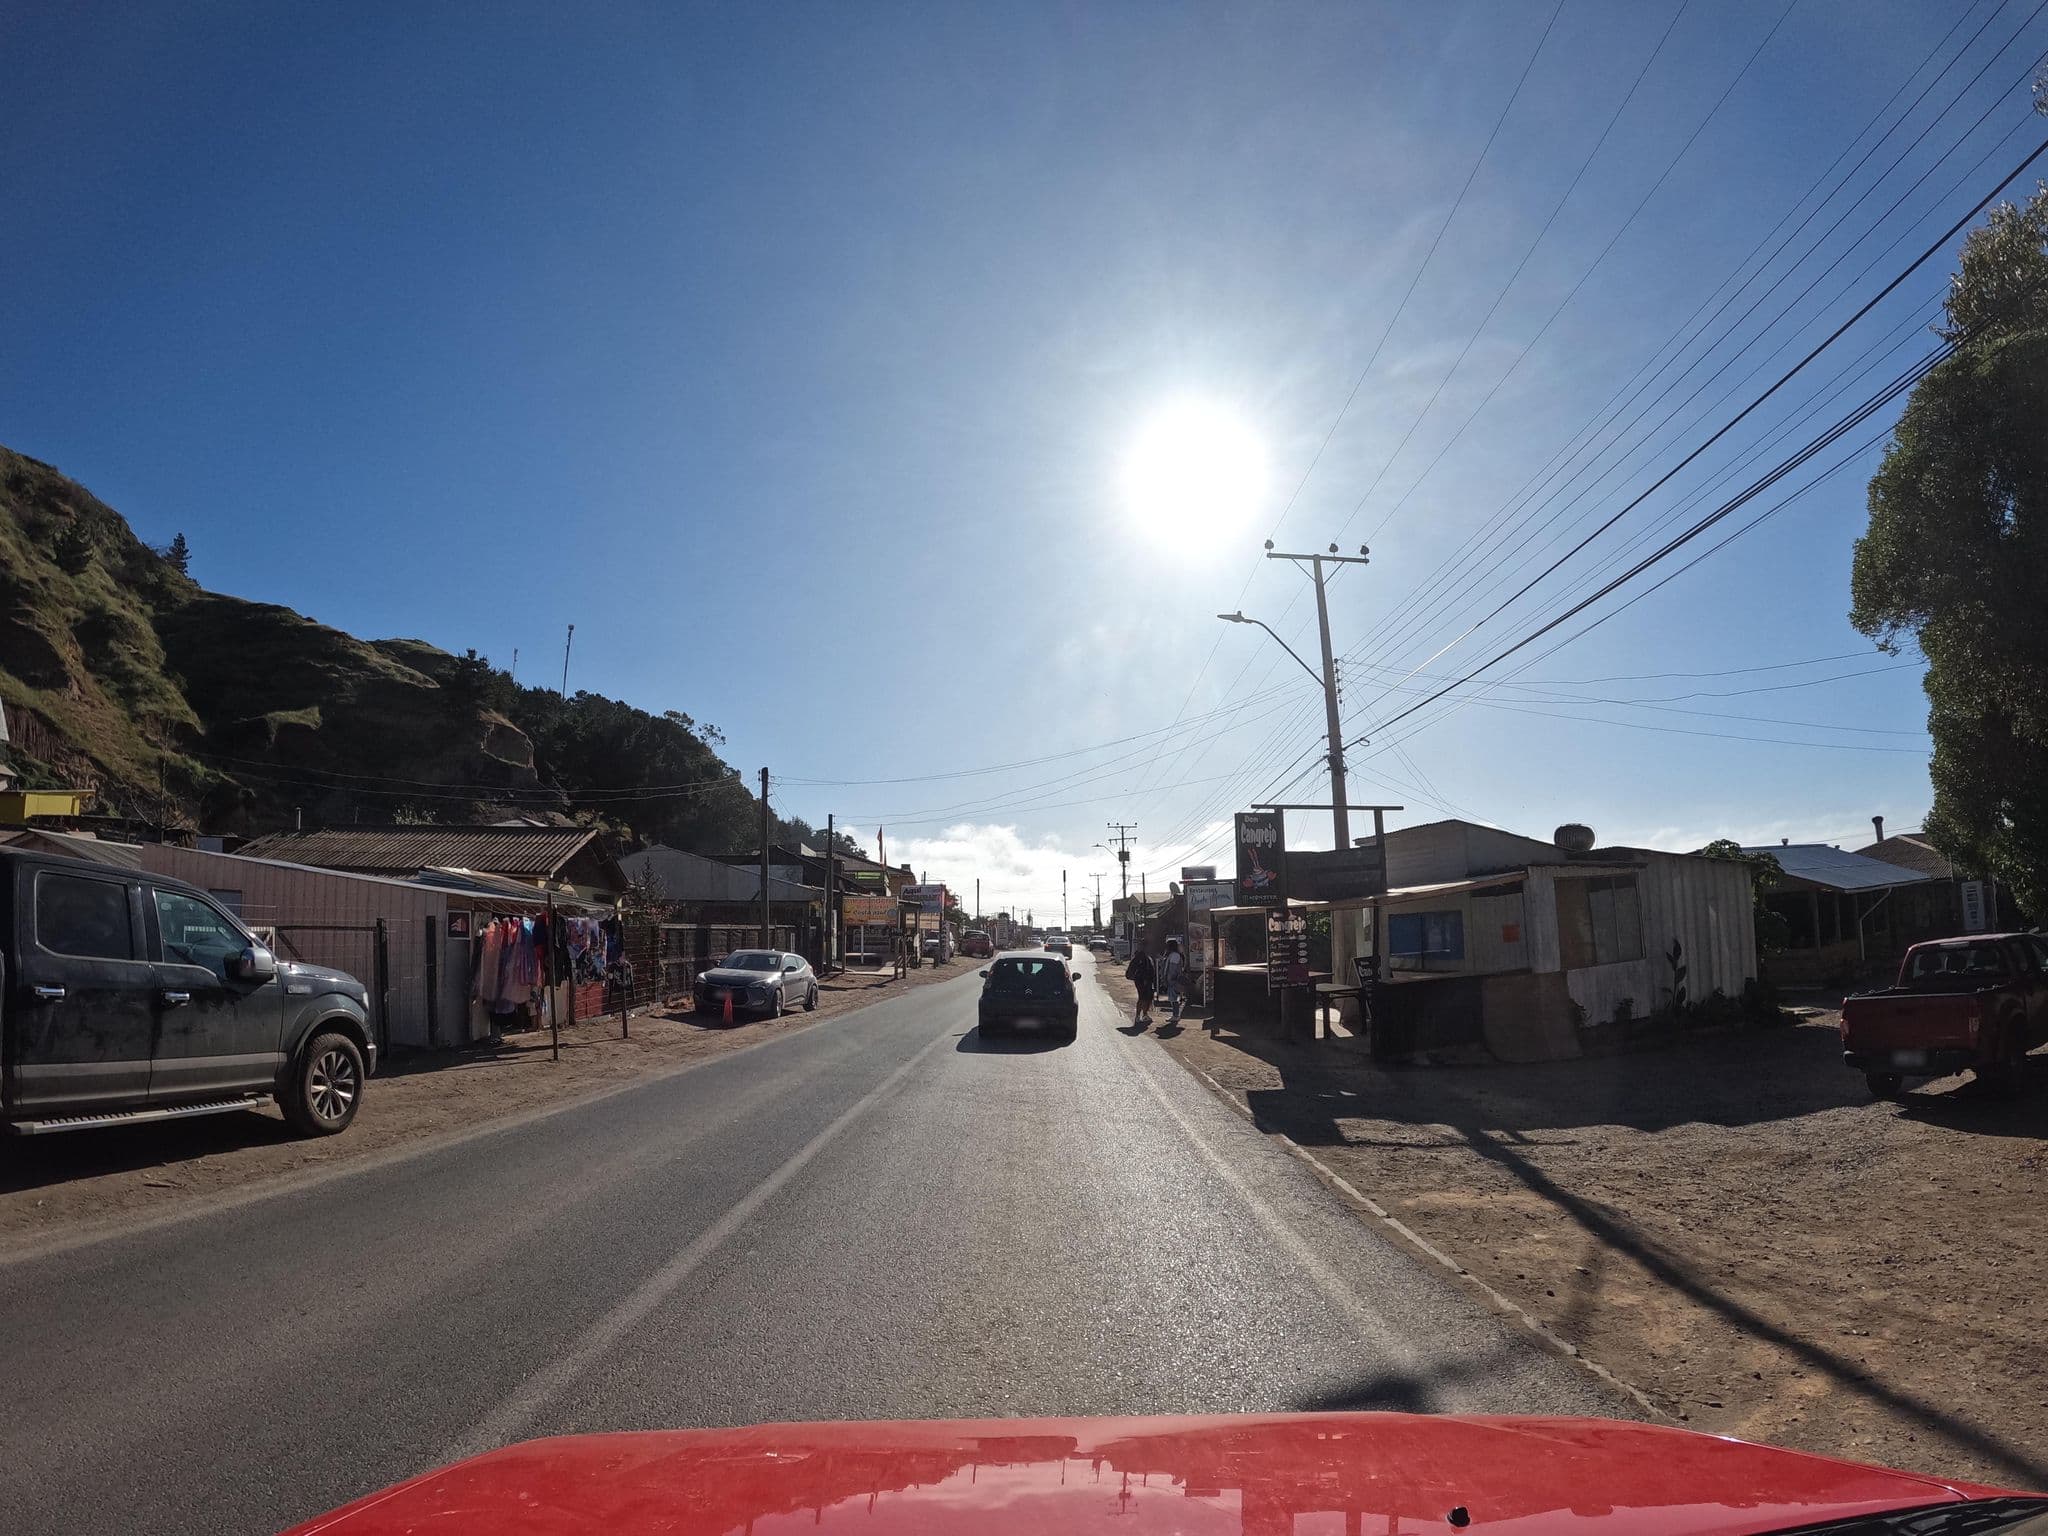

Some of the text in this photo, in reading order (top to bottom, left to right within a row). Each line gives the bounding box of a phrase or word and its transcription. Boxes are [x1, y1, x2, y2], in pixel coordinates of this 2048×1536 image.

[1244, 815, 1259, 823] Don
[1240, 823, 1277, 848] Cangrejo
[1268, 916, 1307, 934] Cangrejo
